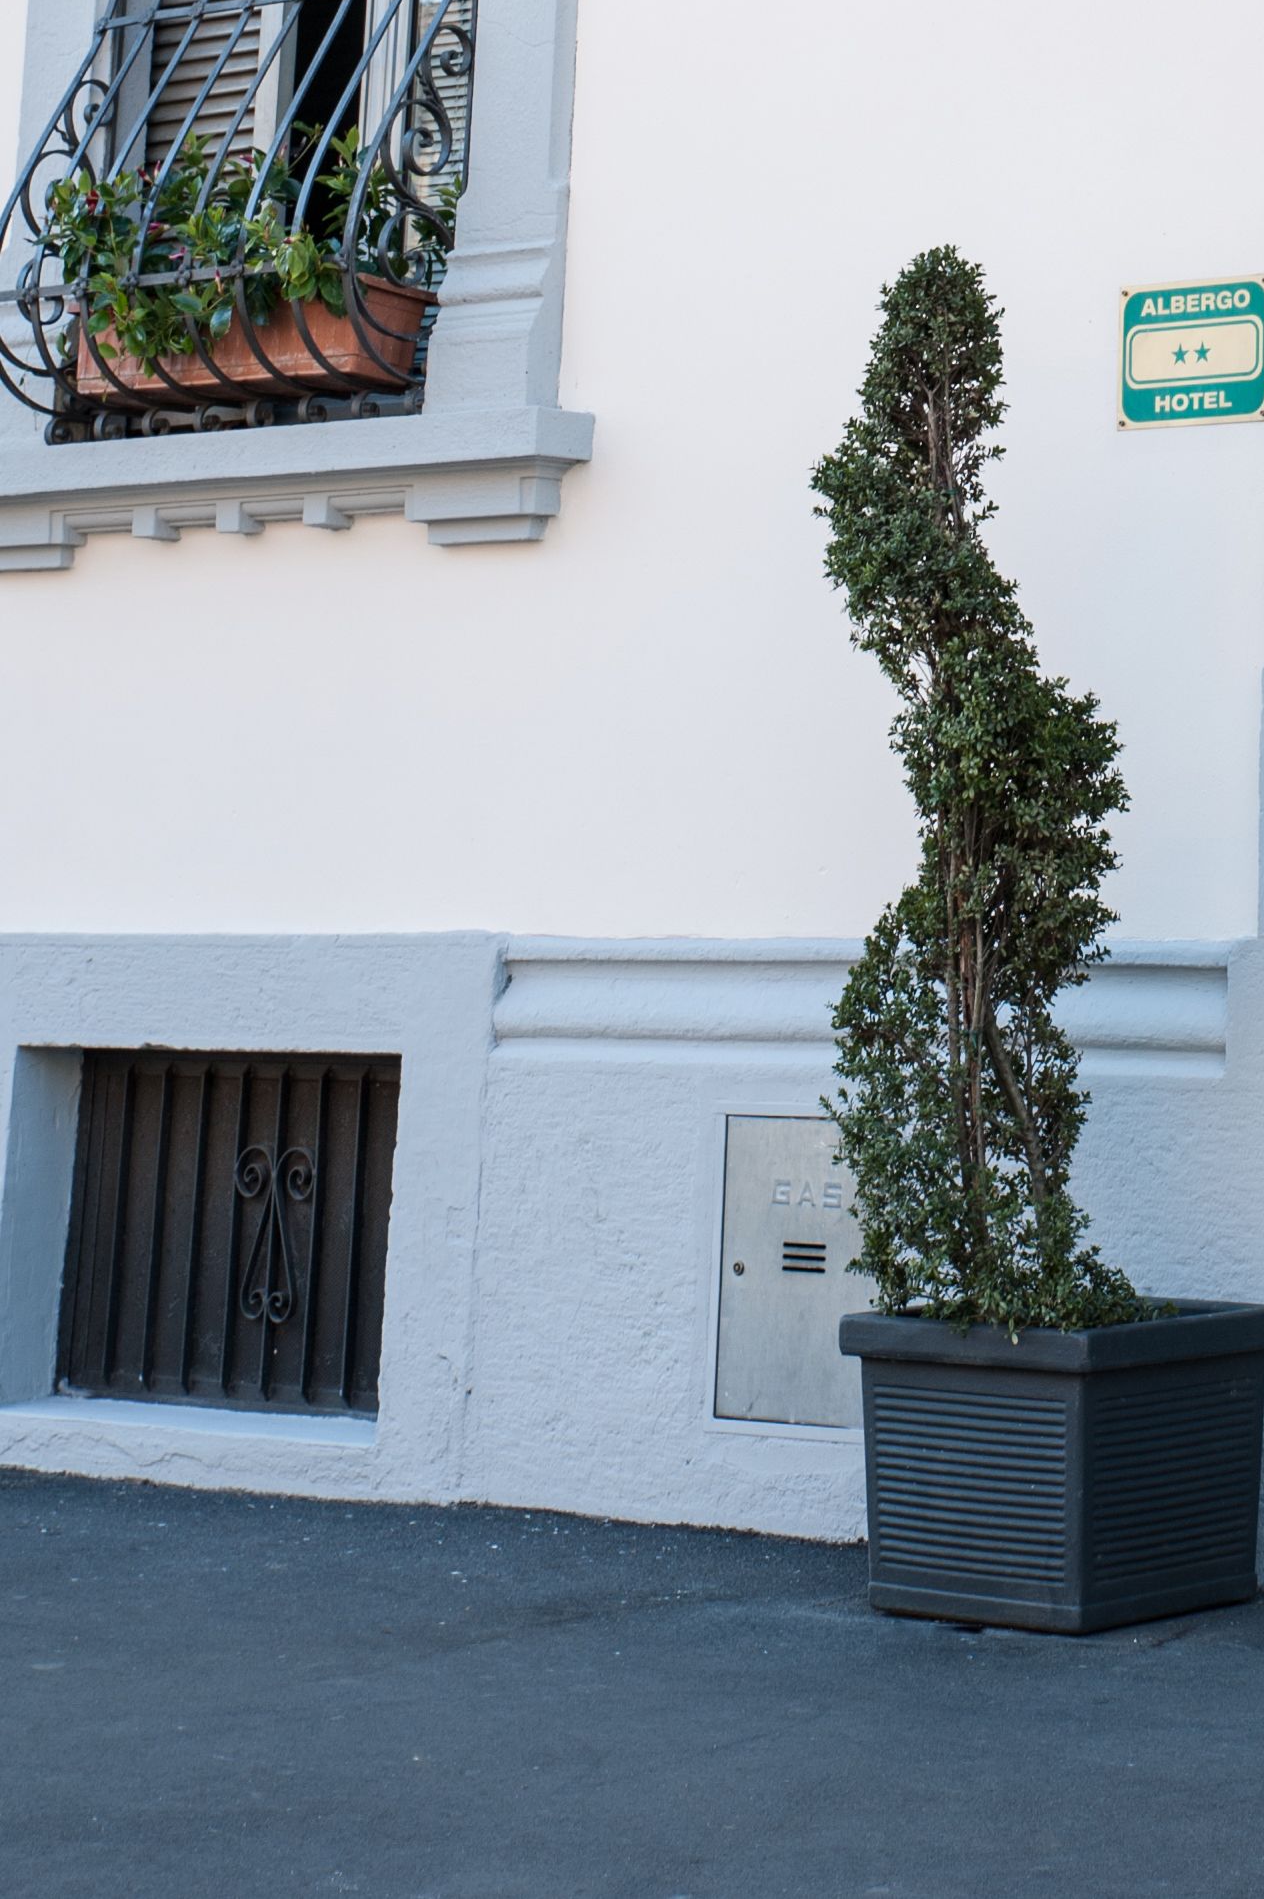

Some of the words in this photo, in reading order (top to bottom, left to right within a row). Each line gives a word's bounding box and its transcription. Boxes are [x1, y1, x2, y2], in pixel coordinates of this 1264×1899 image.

[1141, 289, 1251, 317] ALBERGO
[1155, 391, 1232, 413] HOTEL
[772, 1180, 842, 1208] GAS
